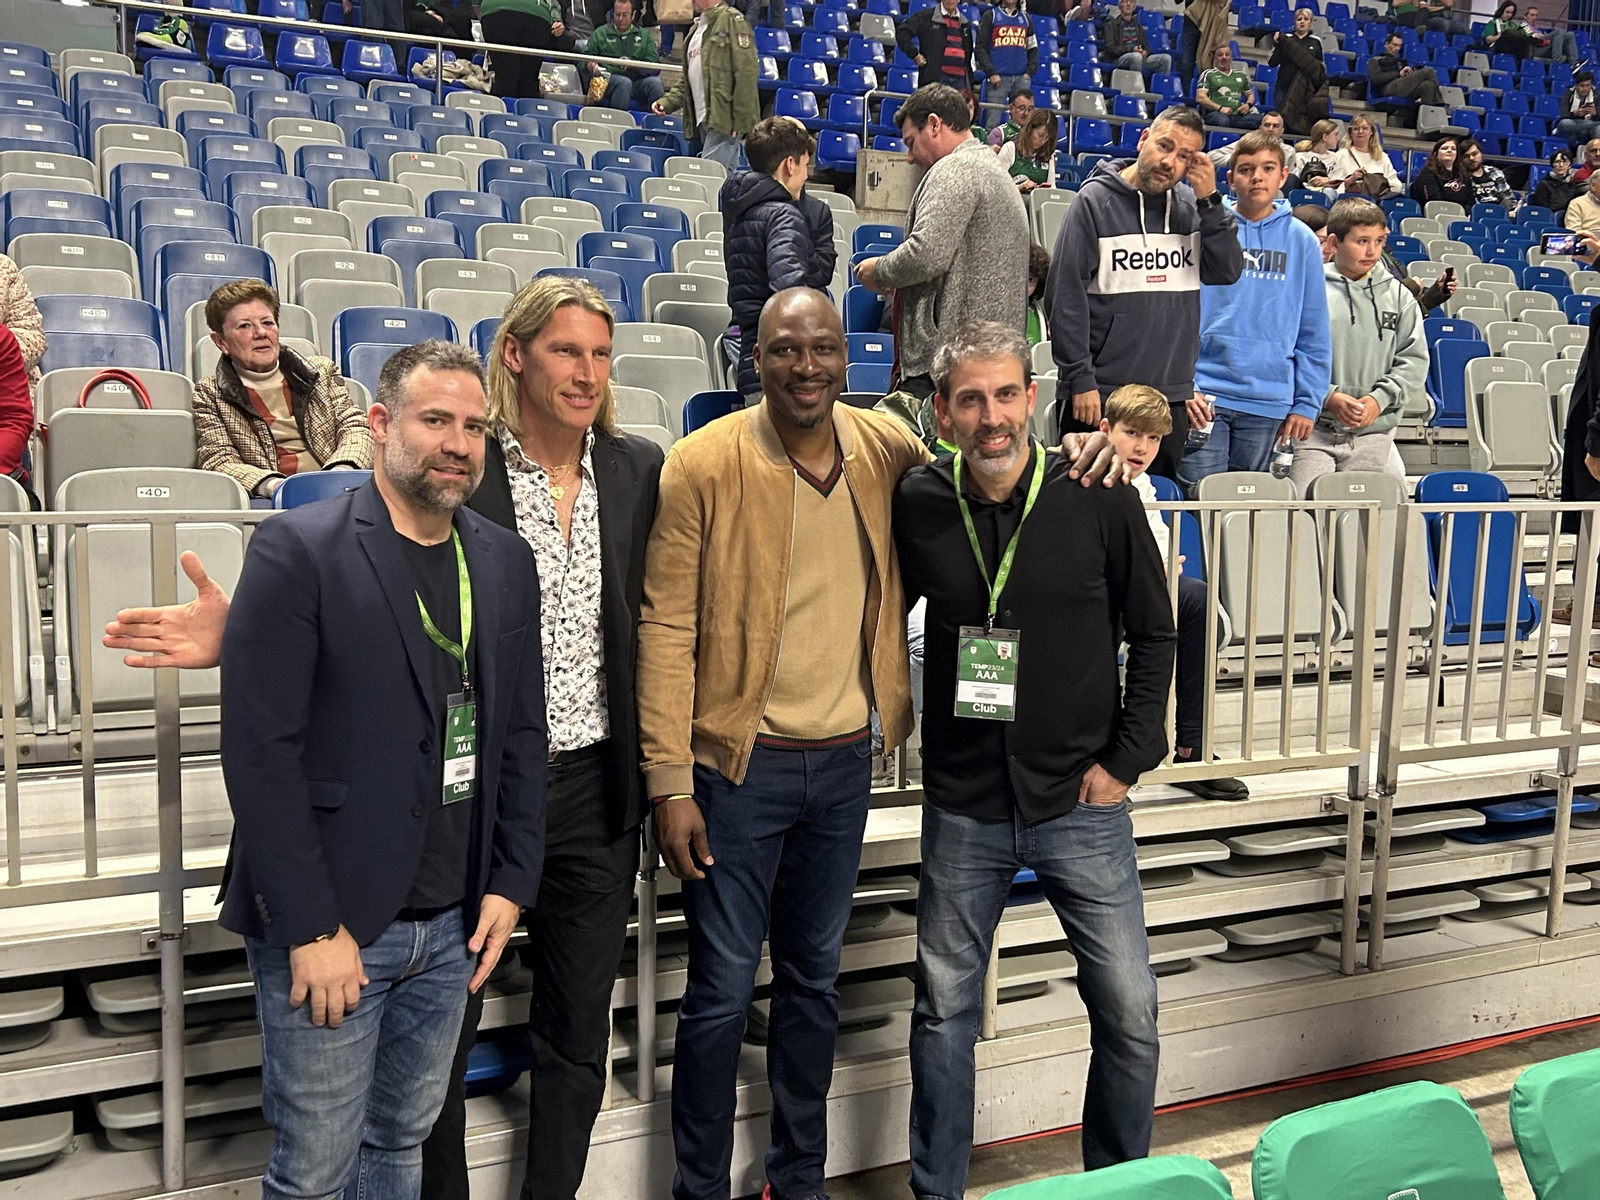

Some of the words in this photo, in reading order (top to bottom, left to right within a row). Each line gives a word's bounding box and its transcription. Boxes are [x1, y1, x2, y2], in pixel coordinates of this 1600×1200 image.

[999, 27, 1026, 37] CAJA
[1112, 247, 1194, 272] Reebok
[975, 670, 998, 680] AAA
[972, 703, 997, 713] Club
[456, 742, 471, 754] AAA
[454, 782, 469, 793] Club
